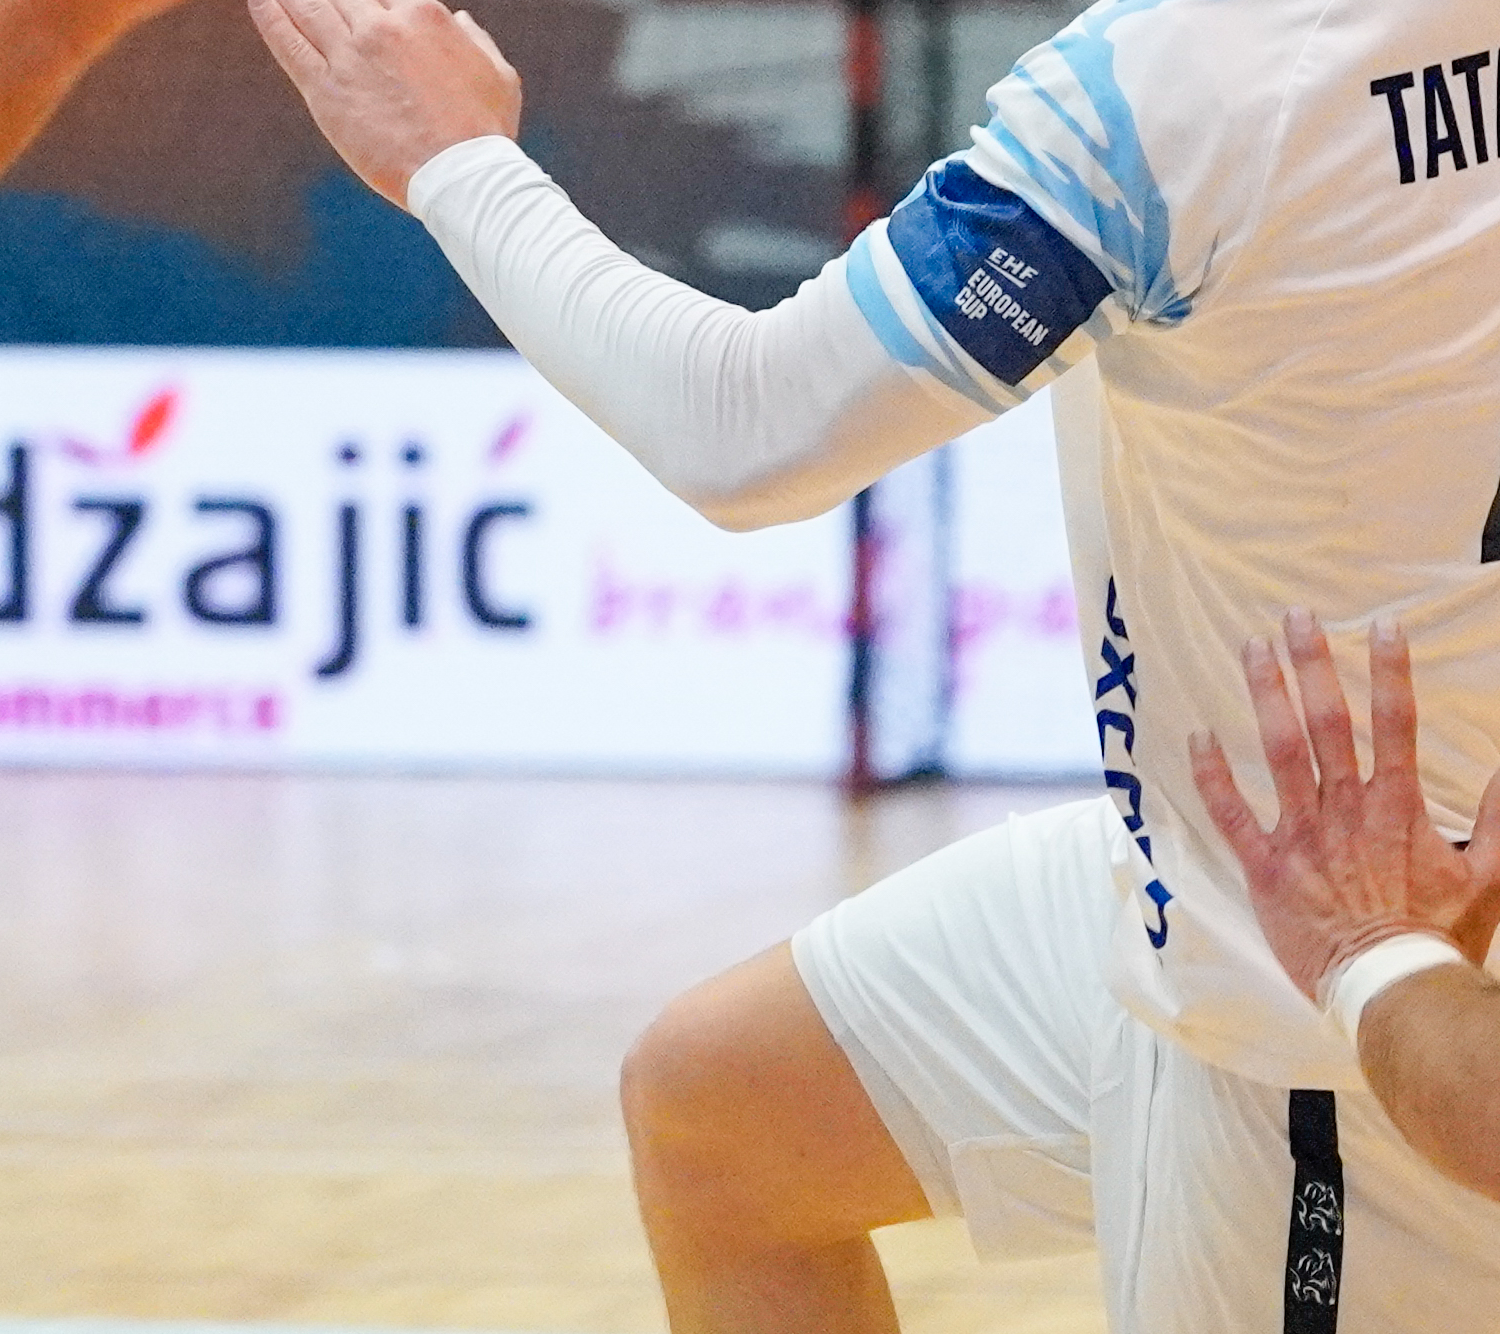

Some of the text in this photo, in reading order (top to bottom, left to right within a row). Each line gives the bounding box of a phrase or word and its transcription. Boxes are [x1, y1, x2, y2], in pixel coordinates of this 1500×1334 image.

[988, 247, 1039, 283] EHF
[954, 286, 990, 323] CUP
[967, 267, 1049, 347] EUROPEAN
